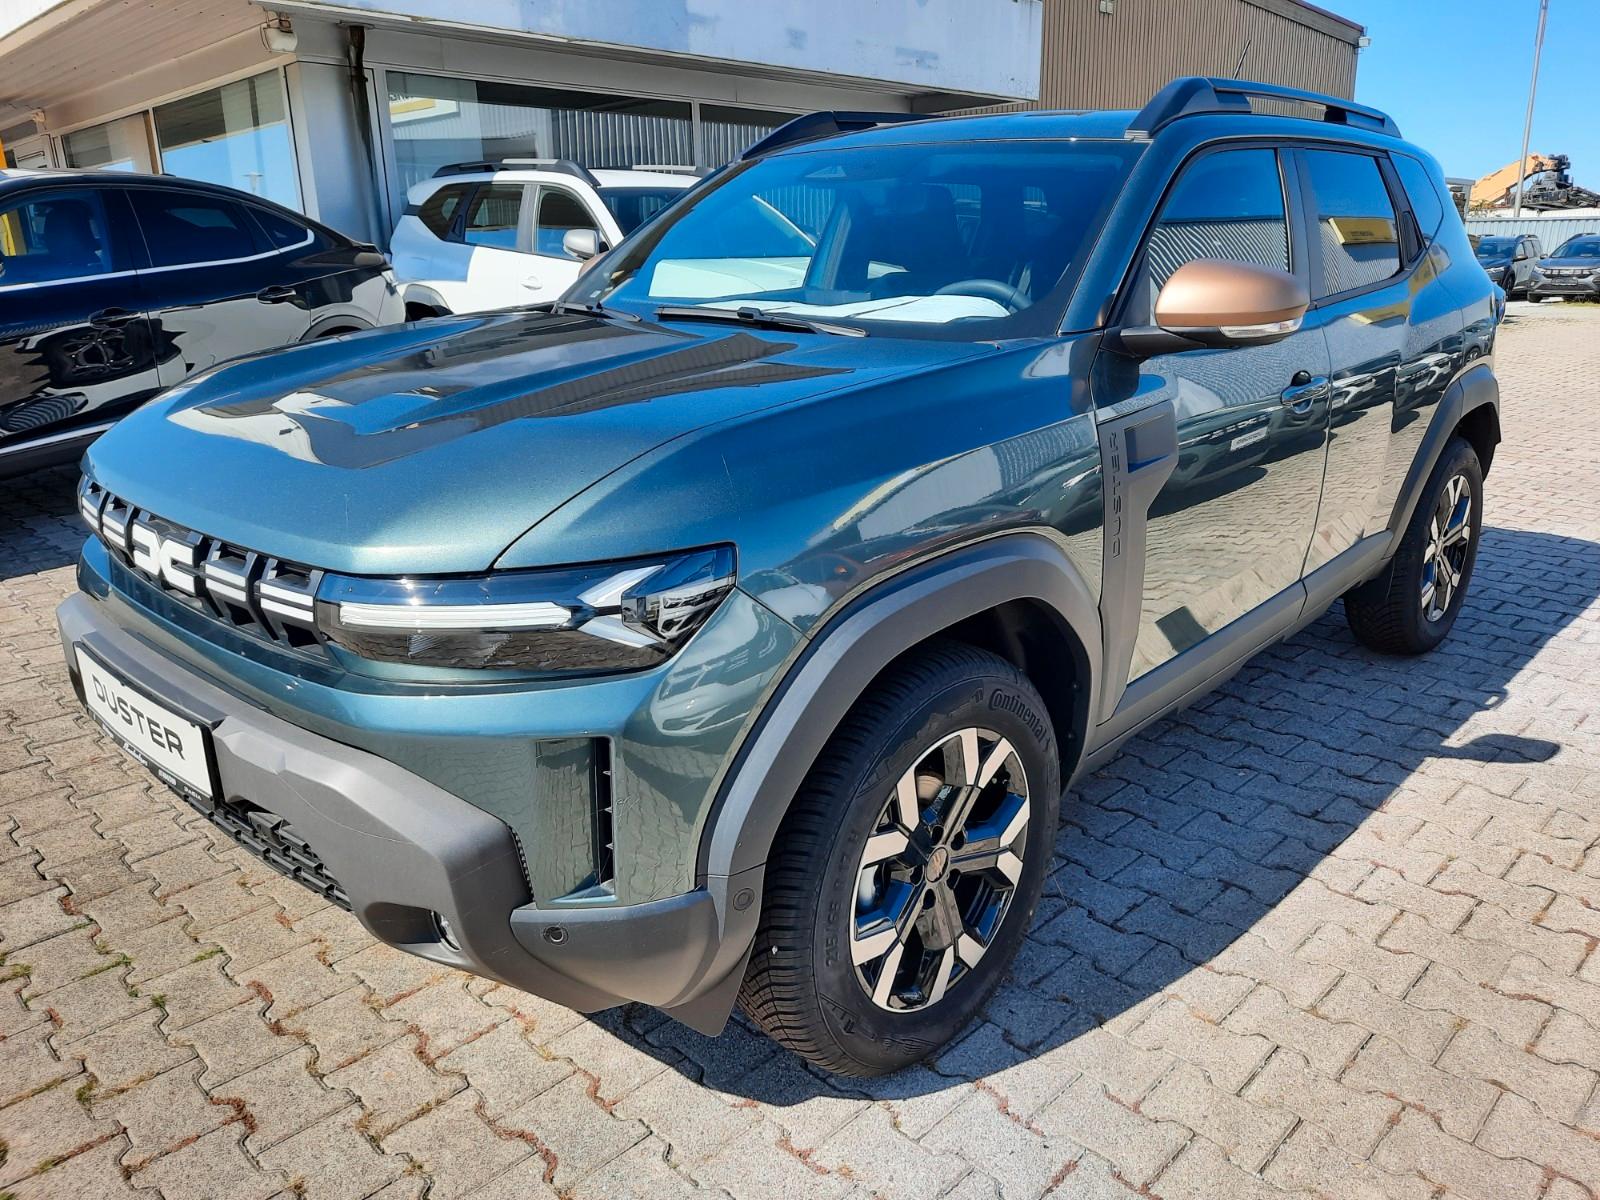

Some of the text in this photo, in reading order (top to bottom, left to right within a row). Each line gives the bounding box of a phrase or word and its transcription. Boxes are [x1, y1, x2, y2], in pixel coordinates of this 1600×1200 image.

[1110, 431, 1122, 558] DUSTER
[92, 674, 186, 761] DUSTER
[988, 688, 1047, 743] Continental
